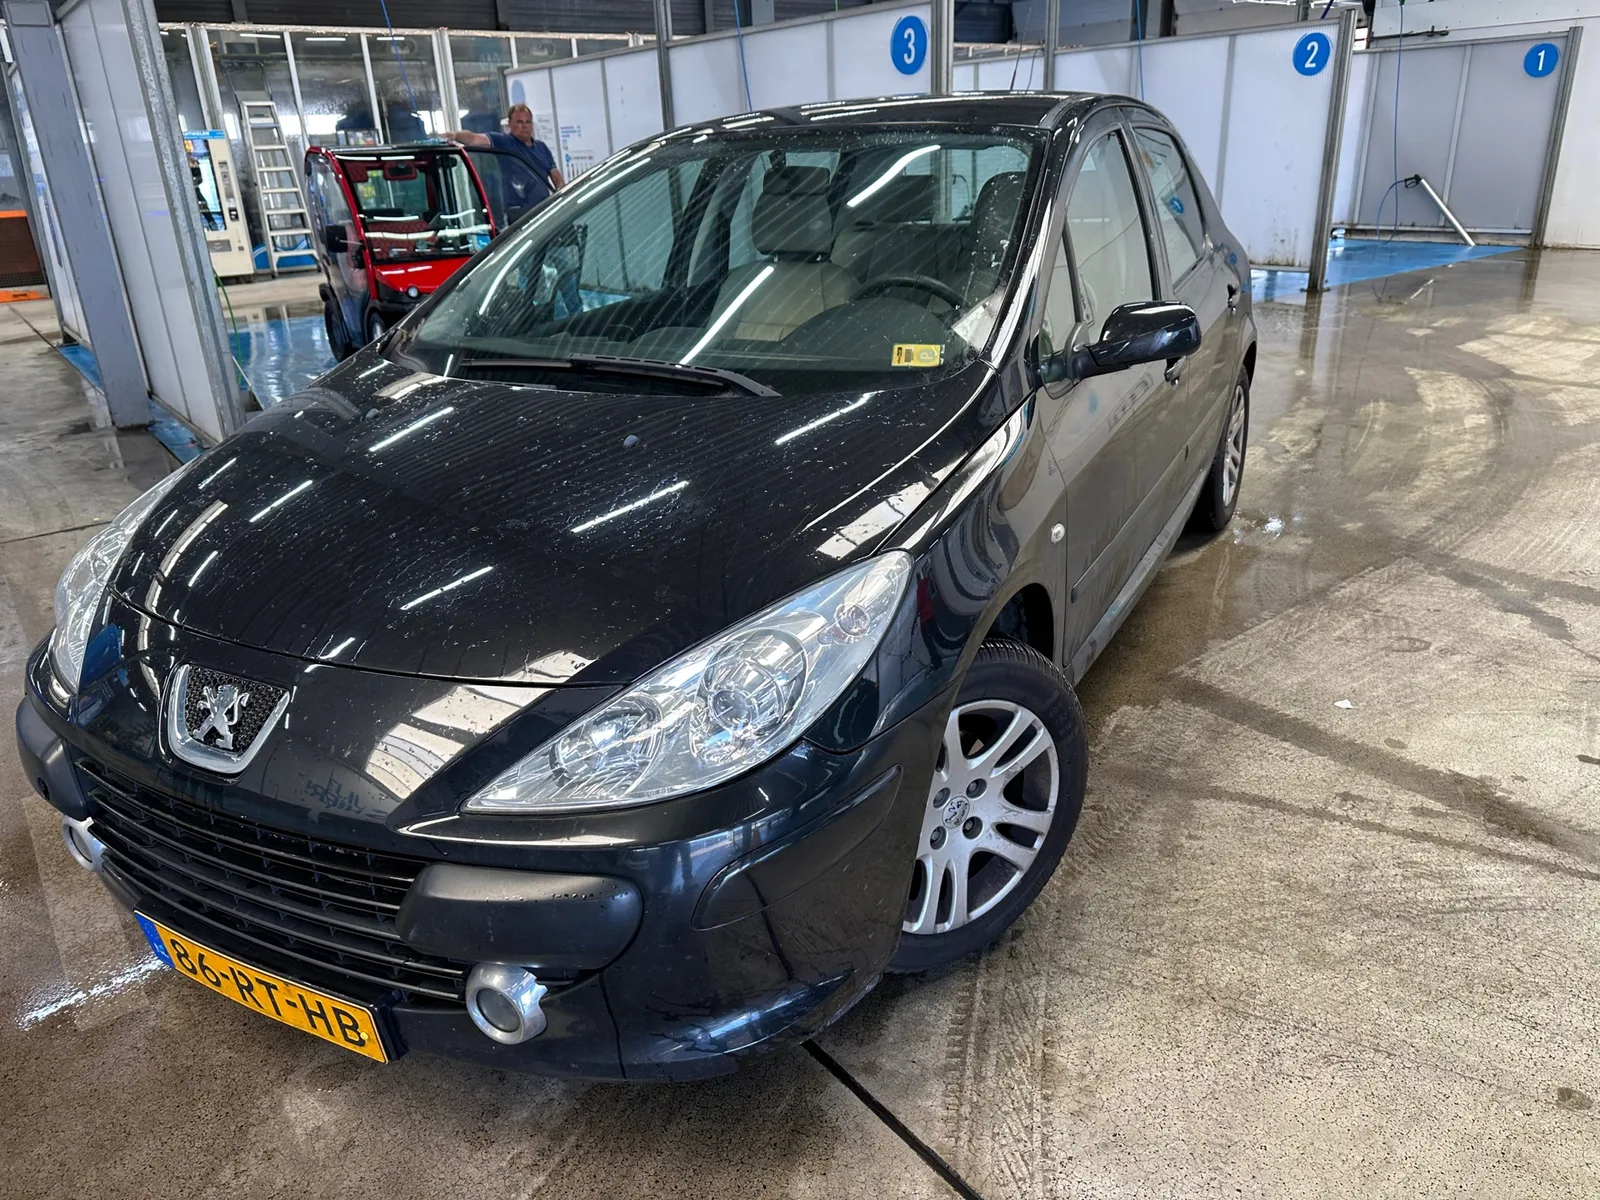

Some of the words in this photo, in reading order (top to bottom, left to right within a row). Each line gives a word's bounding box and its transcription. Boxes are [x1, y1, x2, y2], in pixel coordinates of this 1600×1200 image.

[903, 27, 916, 65] 3
[1304, 40, 1319, 69] 2
[1537, 49, 1546, 71] 1
[170, 938, 366, 1047] 86-RT-HB
